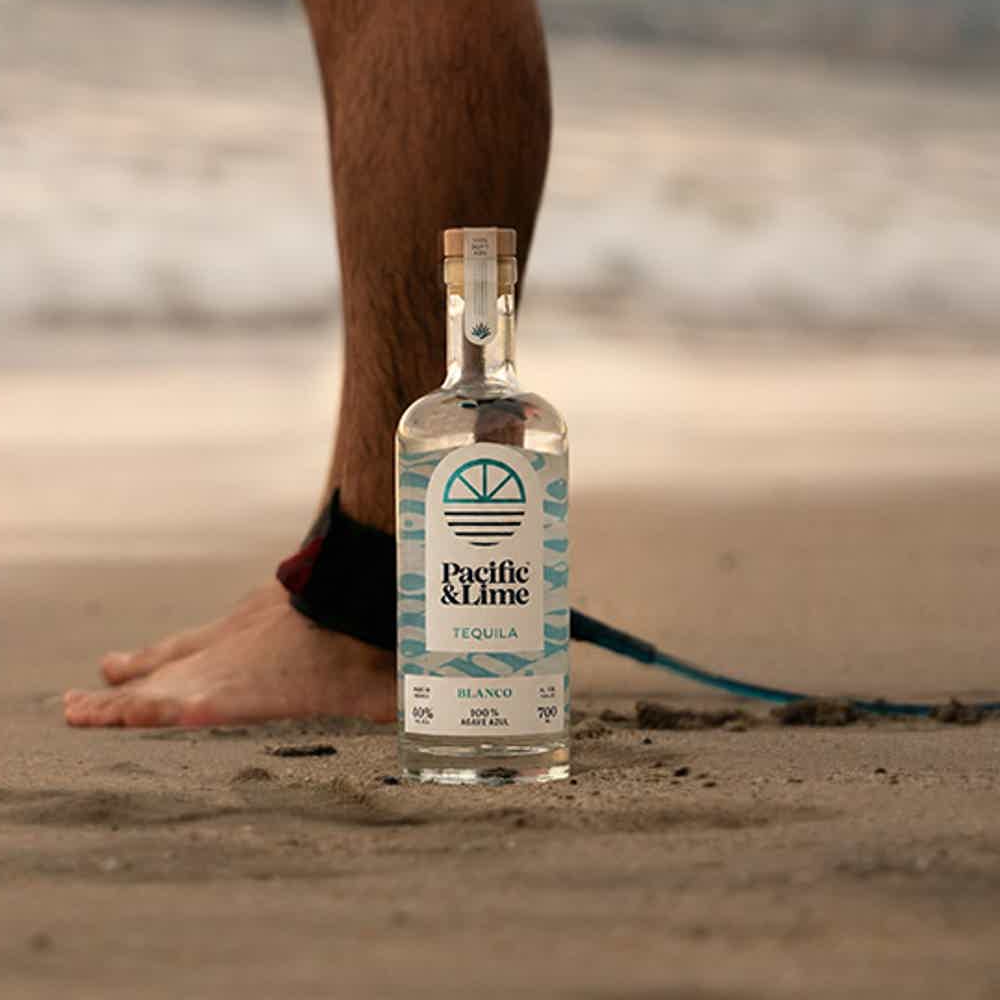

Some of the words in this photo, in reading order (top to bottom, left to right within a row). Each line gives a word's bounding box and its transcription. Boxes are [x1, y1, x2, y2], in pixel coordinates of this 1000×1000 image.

[440, 559, 529, 584] Pacific
[453, 626, 519, 641] TEQUILA
[457, 687, 512, 698] BLANCO
